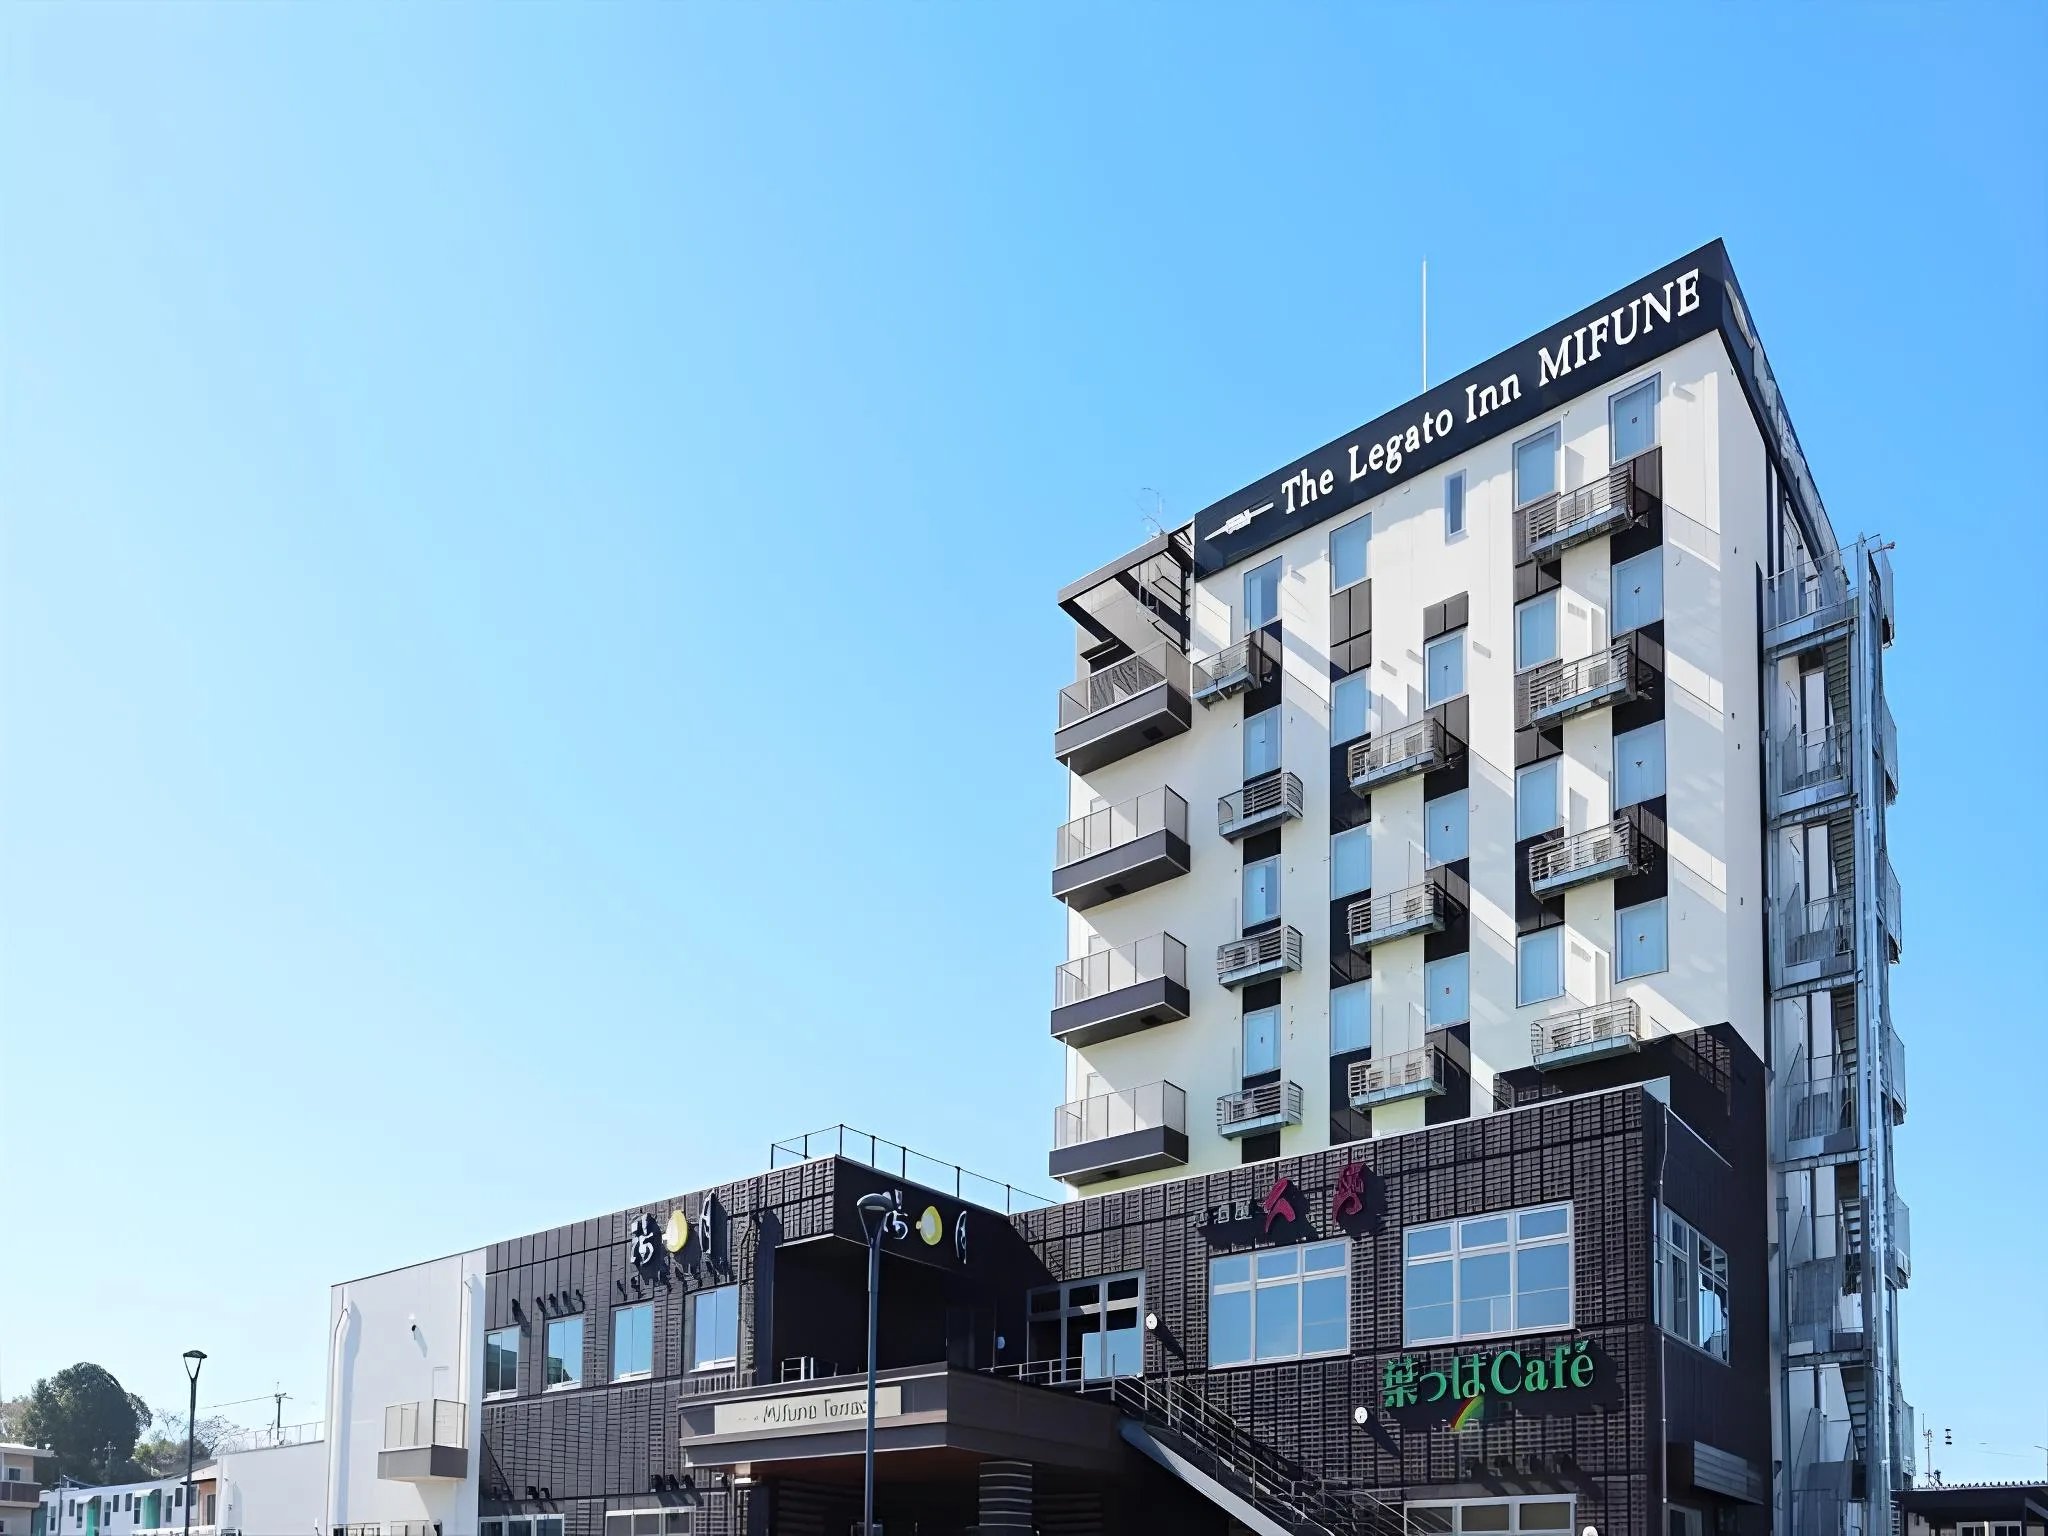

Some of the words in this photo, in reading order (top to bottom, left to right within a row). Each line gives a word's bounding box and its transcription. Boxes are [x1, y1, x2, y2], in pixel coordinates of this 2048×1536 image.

[1281, 467, 1335, 516] The
[1347, 407, 1455, 481] Legato
[1465, 372, 1522, 425] Inn
[1537, 267, 1701, 388] MIFUNE
